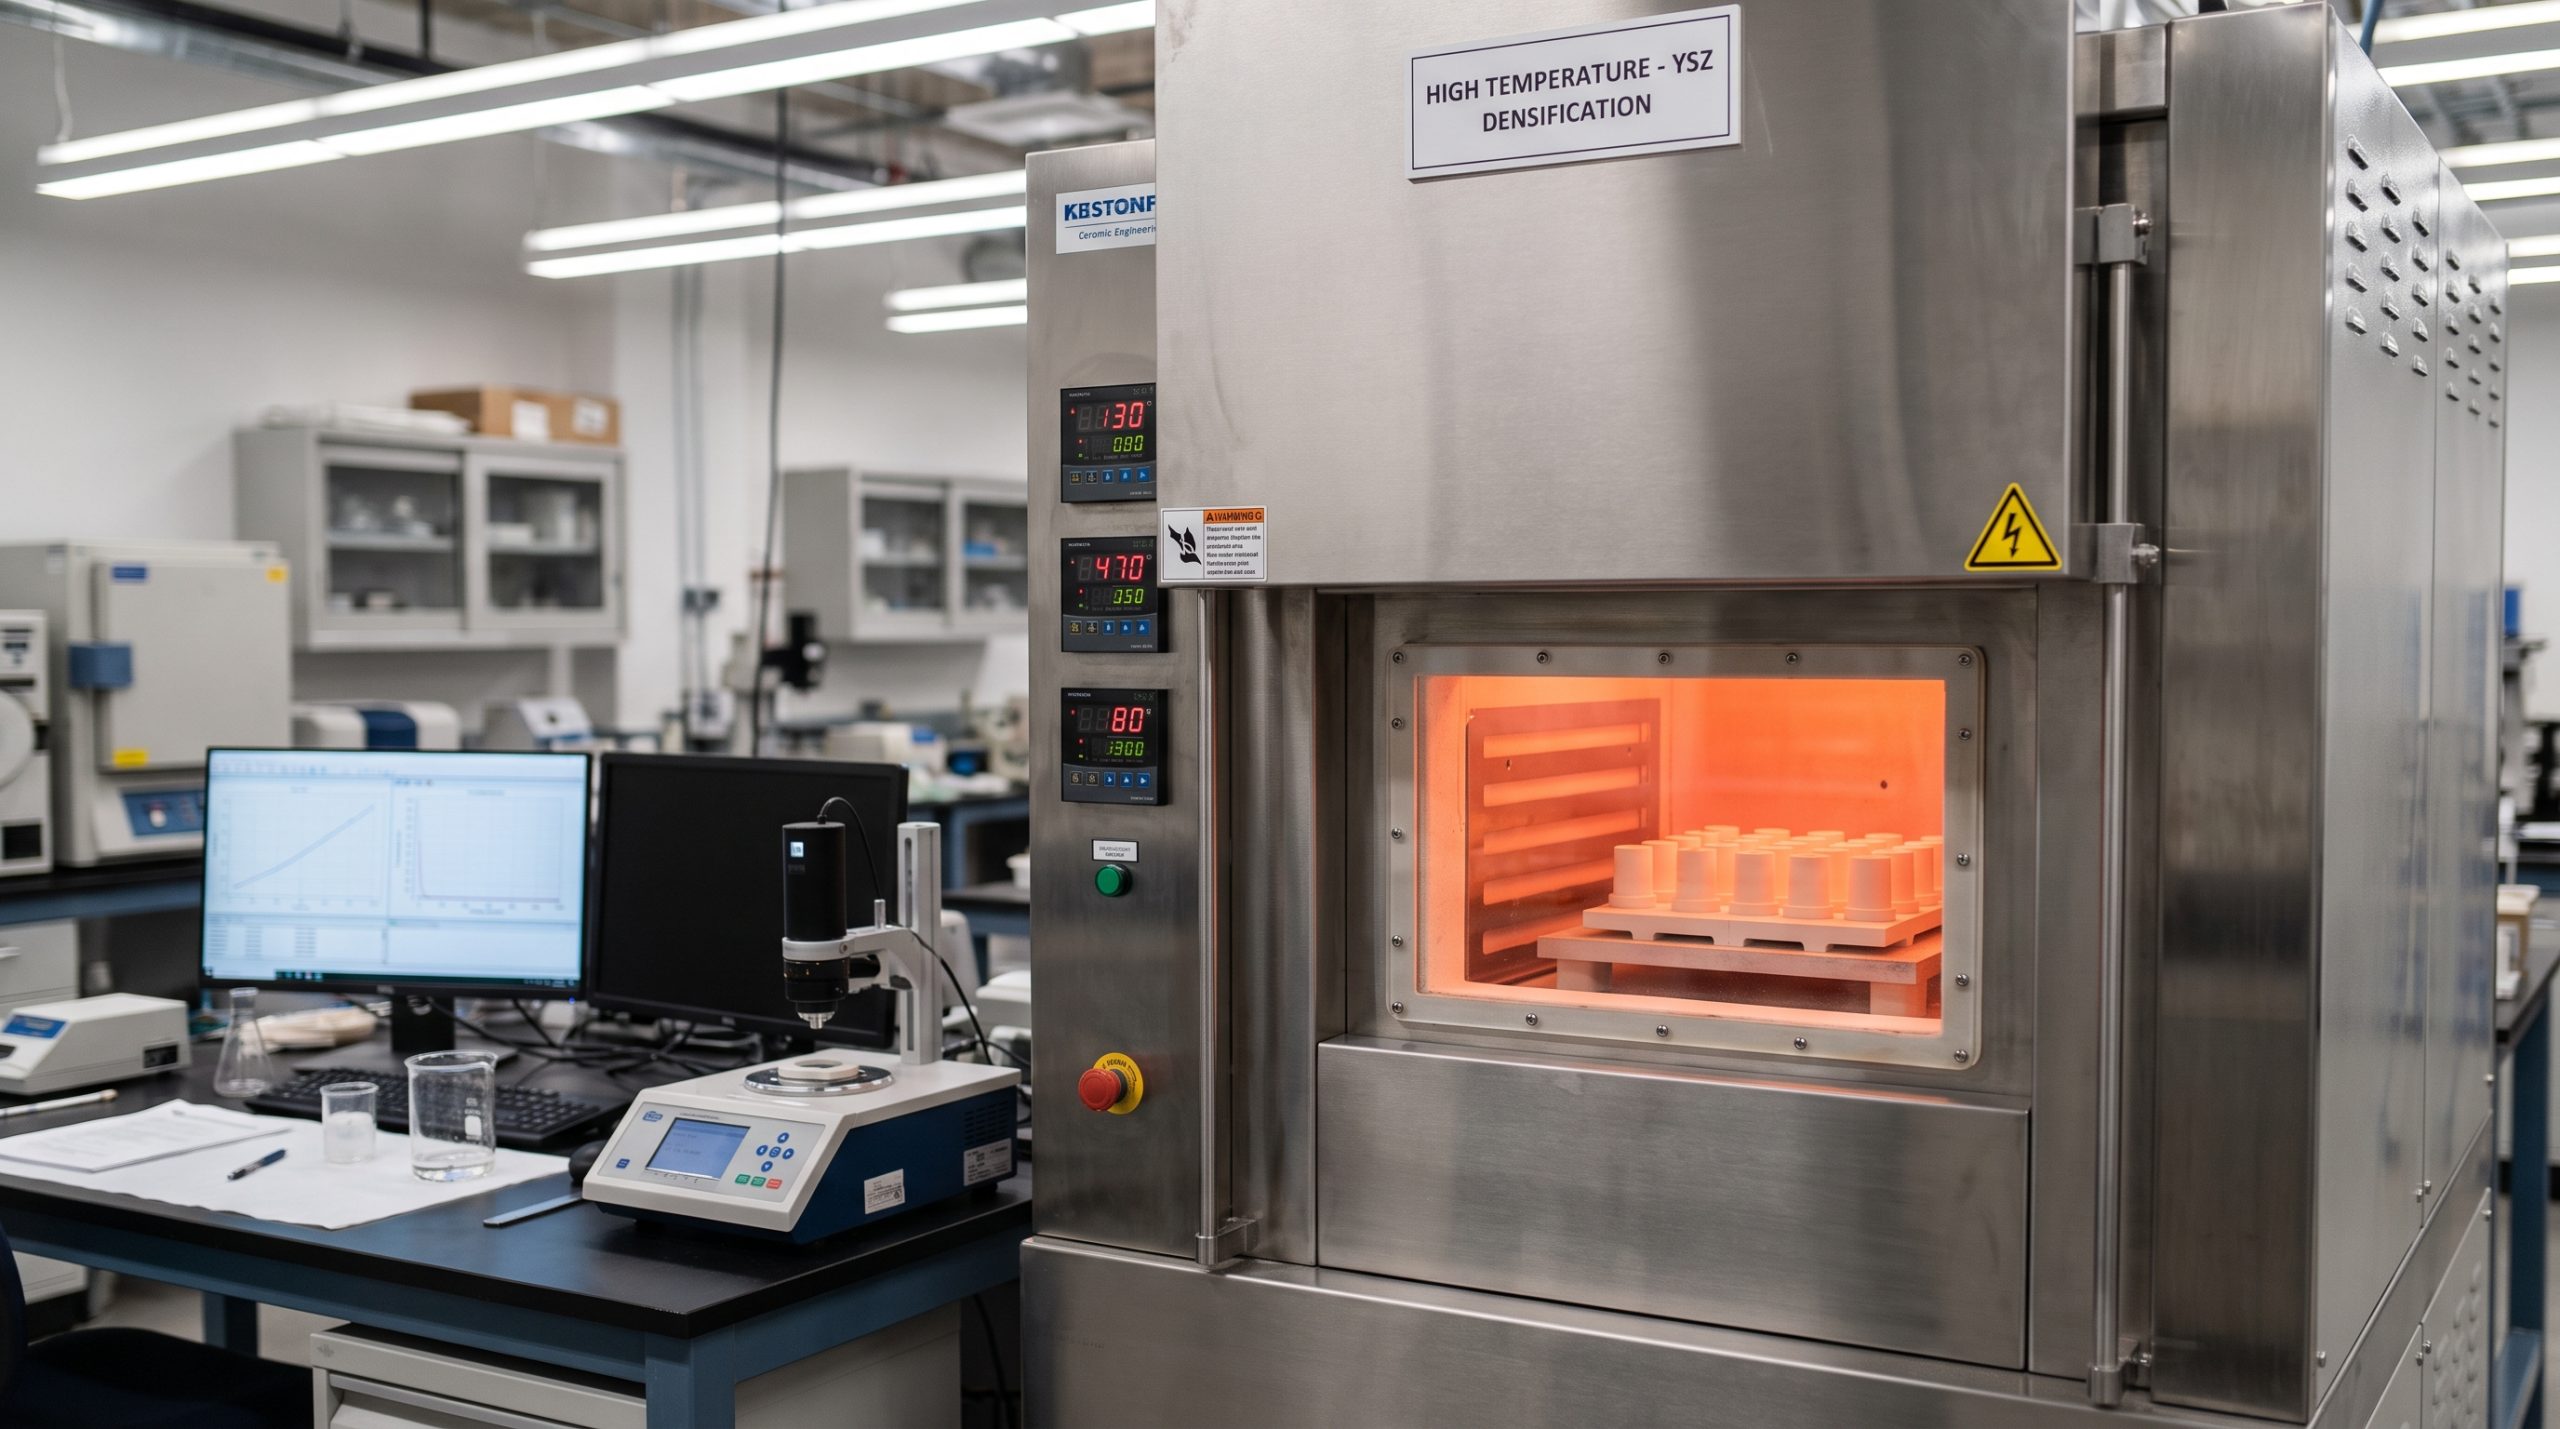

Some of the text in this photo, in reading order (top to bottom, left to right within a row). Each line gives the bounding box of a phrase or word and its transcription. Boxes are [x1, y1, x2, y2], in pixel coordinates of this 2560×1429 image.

[1426, 79, 1479, 105] HIGH
[1485, 57, 1650, 97] TEMPERATURE
[1672, 50, 1714, 75] YSZ
[1483, 94, 1651, 132] DENSIFICATION
[1103, 401, 1144, 429] 130
[1096, 554, 1144, 580] 470
